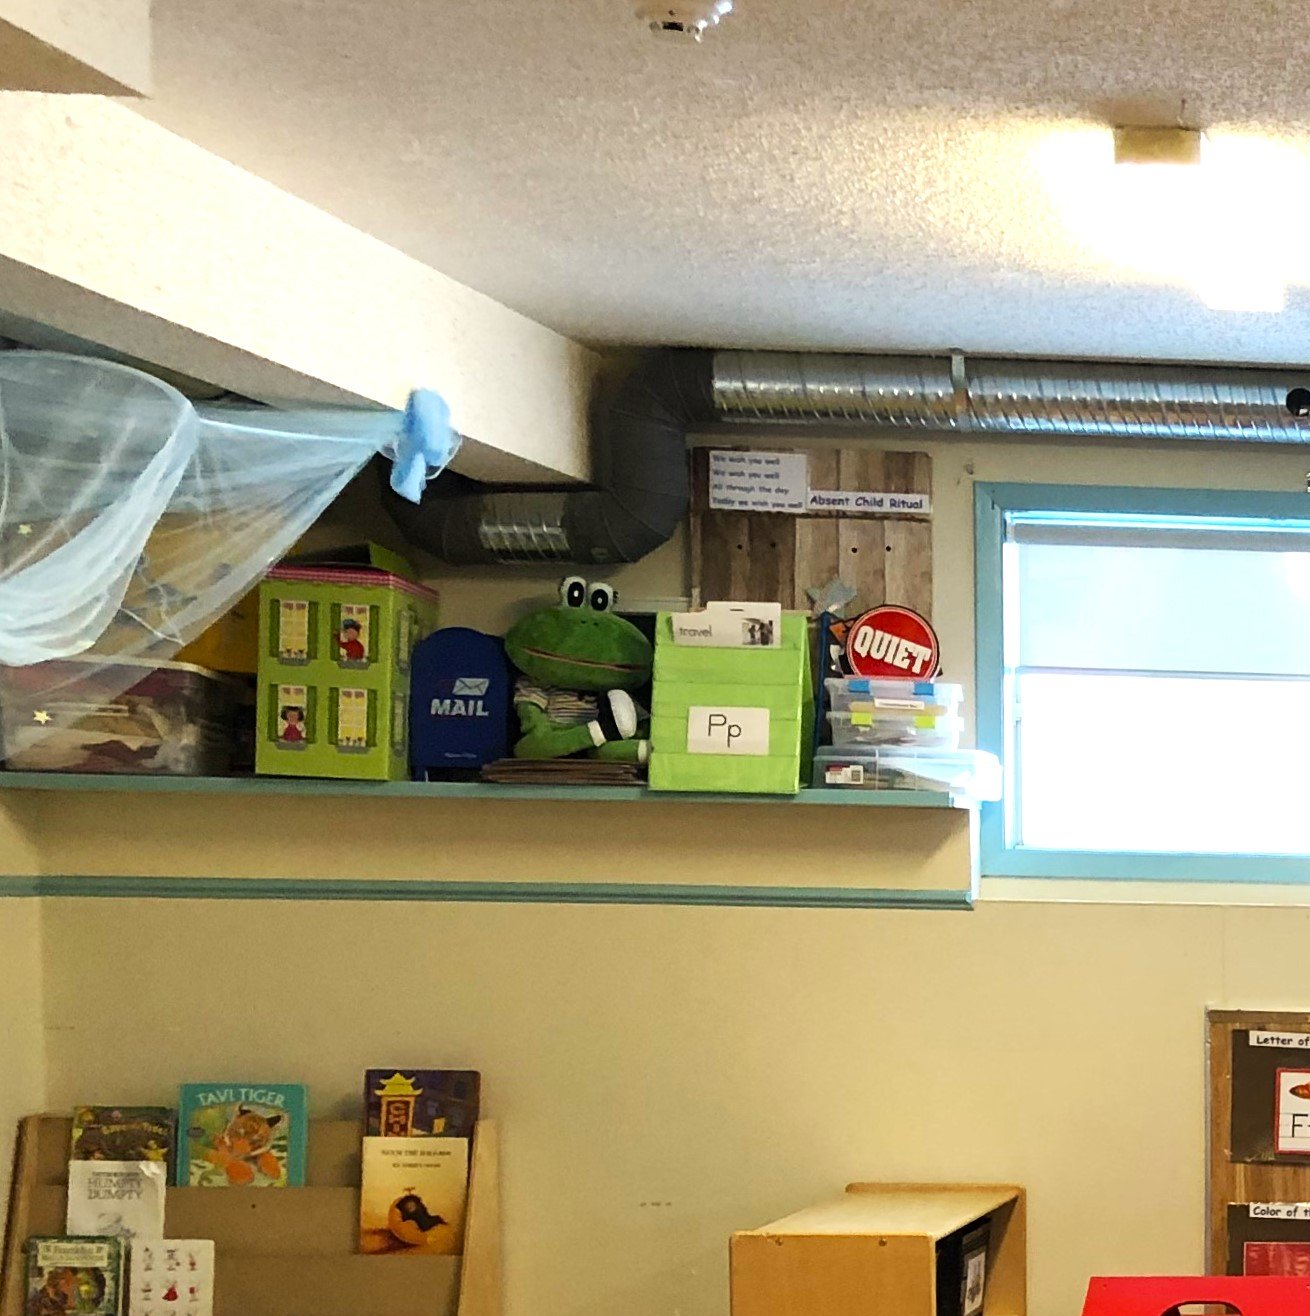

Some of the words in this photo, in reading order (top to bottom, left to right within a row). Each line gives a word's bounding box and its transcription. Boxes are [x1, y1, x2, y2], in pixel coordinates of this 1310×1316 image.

[810, 495, 849, 506] Absent
[855, 496, 883, 507] Child
[890, 498, 922, 509] Ritual
[679, 626, 712, 638] travel
[854, 625, 932, 675] QUIET
[430, 698, 489, 717] MAIL
[707, 714, 741, 747] Pp
[1257, 1035, 1293, 1046] Letter
[1298, 1036, 1310, 1046] of
[239, 1088, 286, 1108] TIGER
[1253, 1206, 1281, 1216] Color
[1286, 1206, 1299, 1217] of
